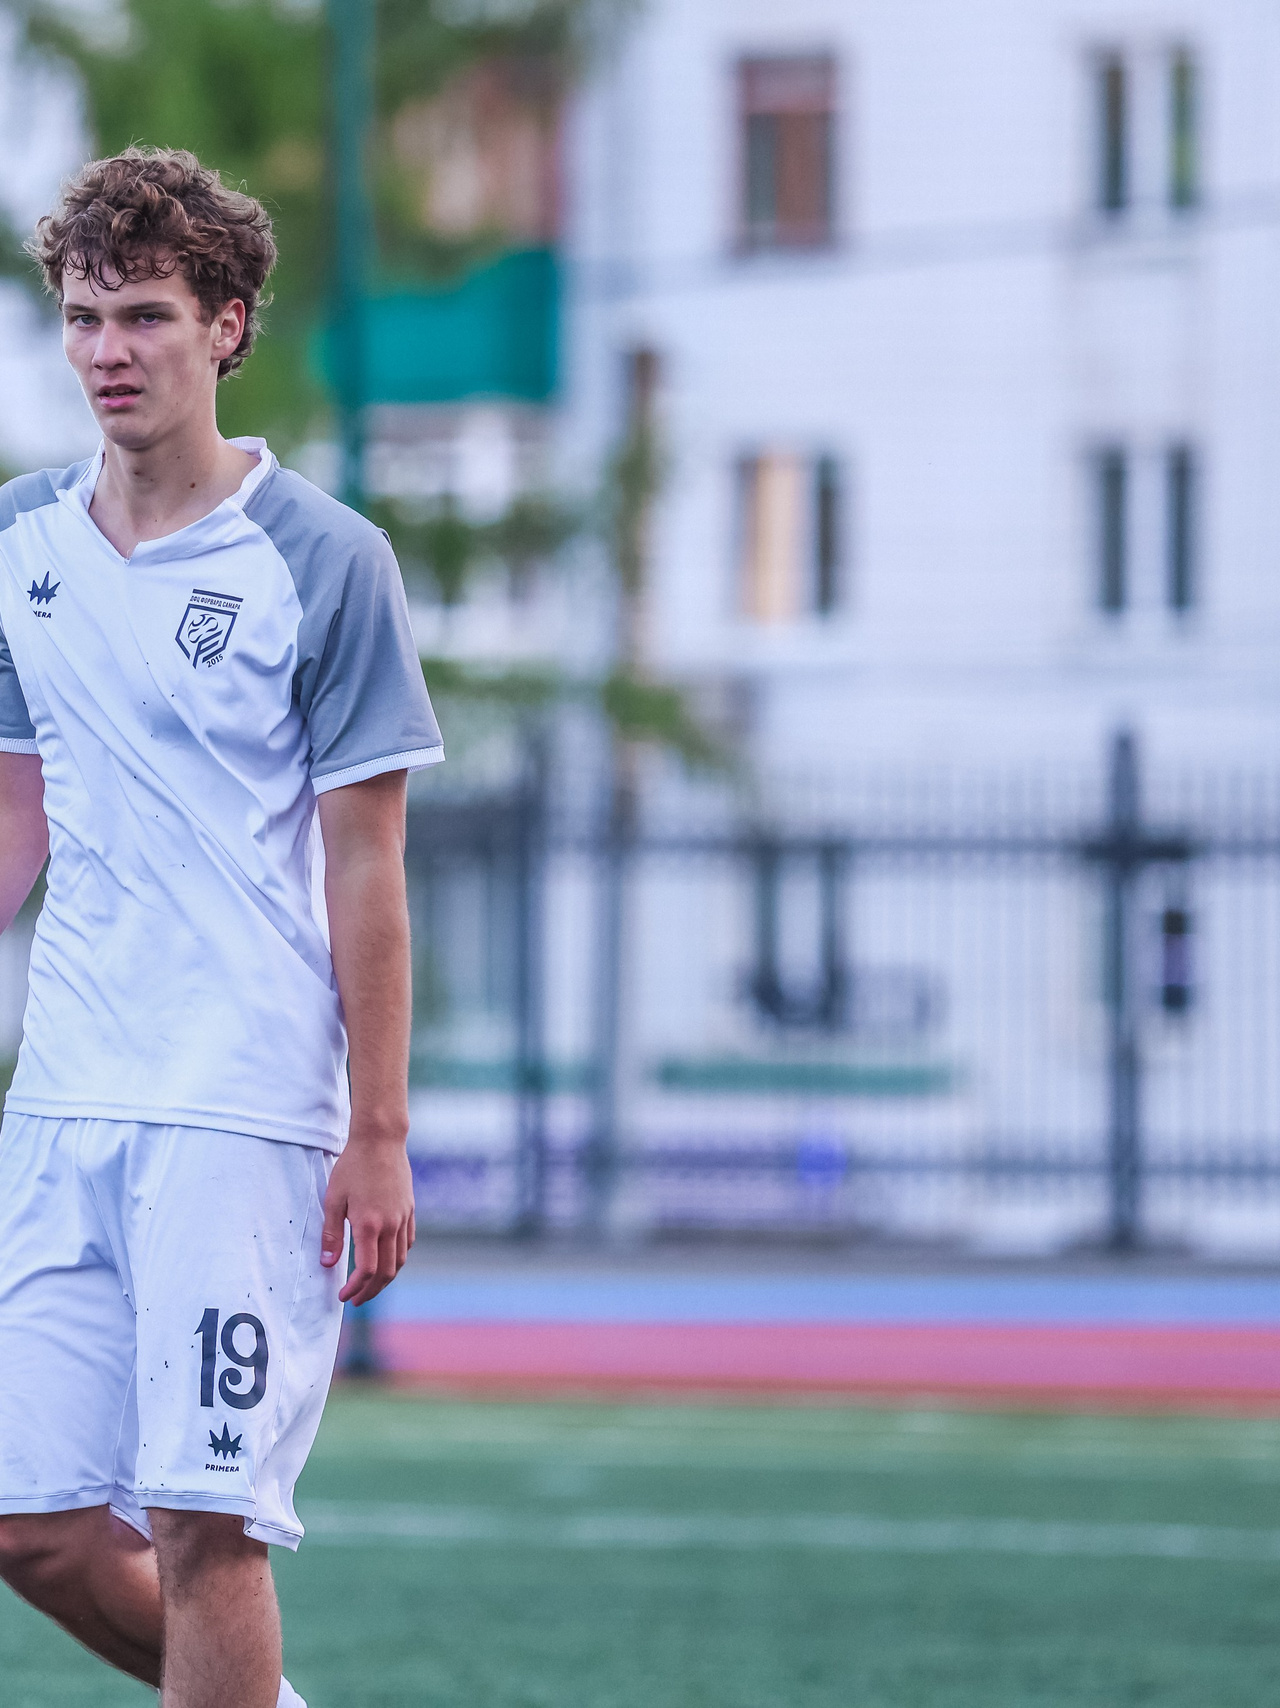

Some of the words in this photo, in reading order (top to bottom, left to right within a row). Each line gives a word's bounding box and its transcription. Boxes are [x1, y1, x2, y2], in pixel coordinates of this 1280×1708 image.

[222, 601, 241, 609] САМАРА
[206, 653, 224, 668] 2015
[193, 1307, 270, 1410] 19
[205, 1463, 240, 1473] PRIMERA
